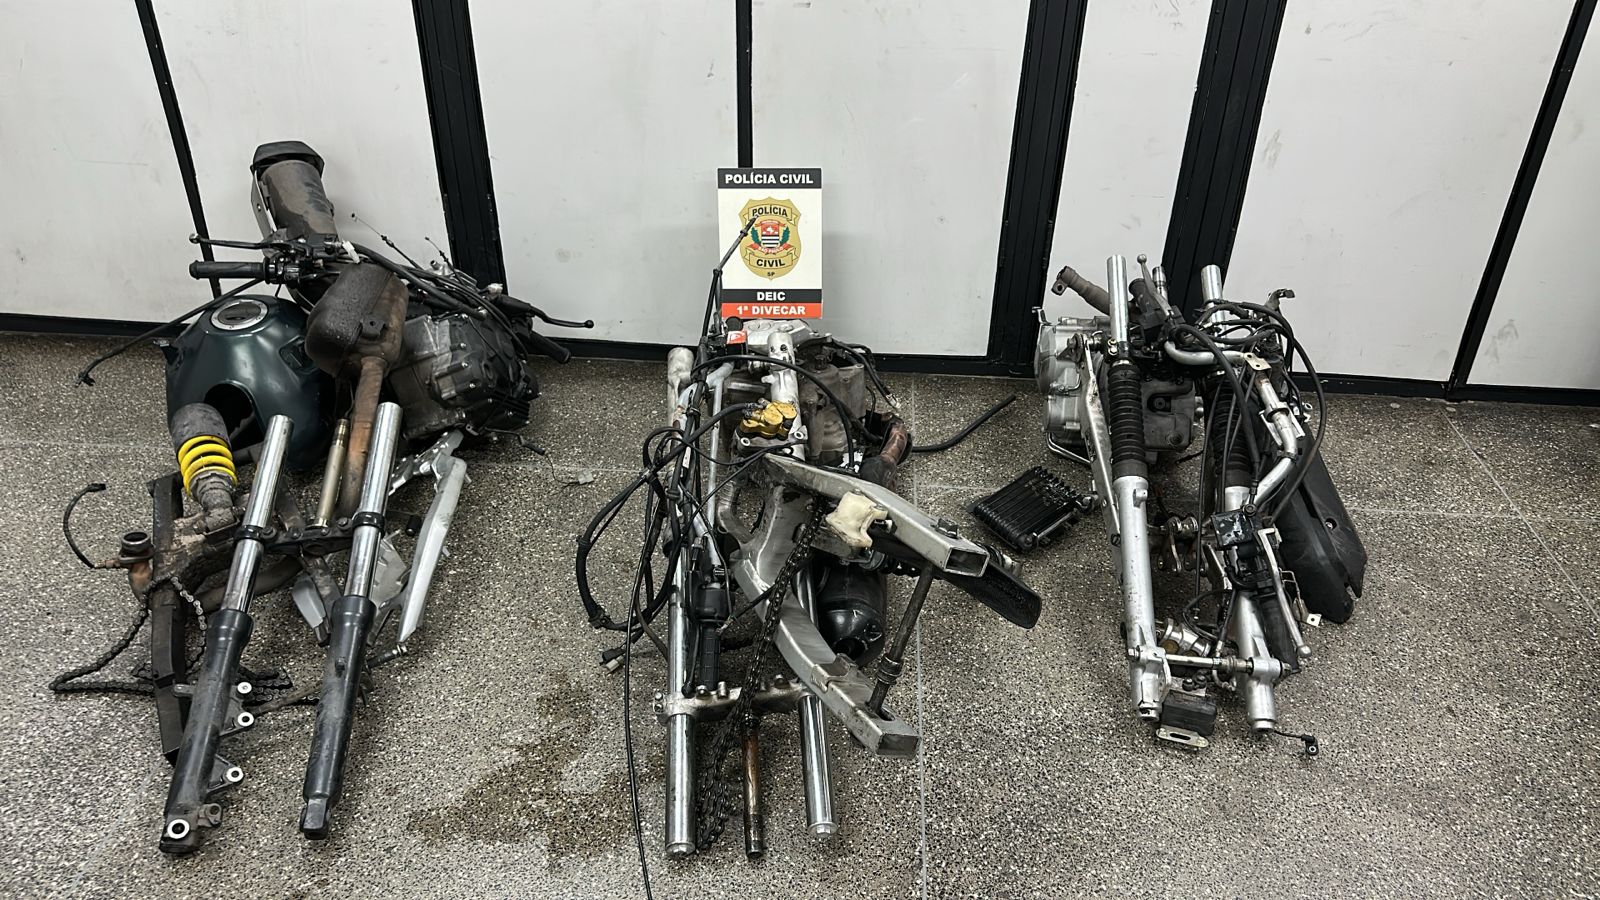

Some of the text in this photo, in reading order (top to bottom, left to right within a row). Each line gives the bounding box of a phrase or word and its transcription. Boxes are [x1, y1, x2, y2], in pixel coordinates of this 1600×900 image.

[725, 172, 814, 184] POLÍCIA CIVIL
[752, 205, 788, 217] POLÍCIA
[756, 259, 786, 268] CIVIL
[757, 292, 786, 301] DEIC
[737, 306, 806, 315] 1ª DIVECAR
